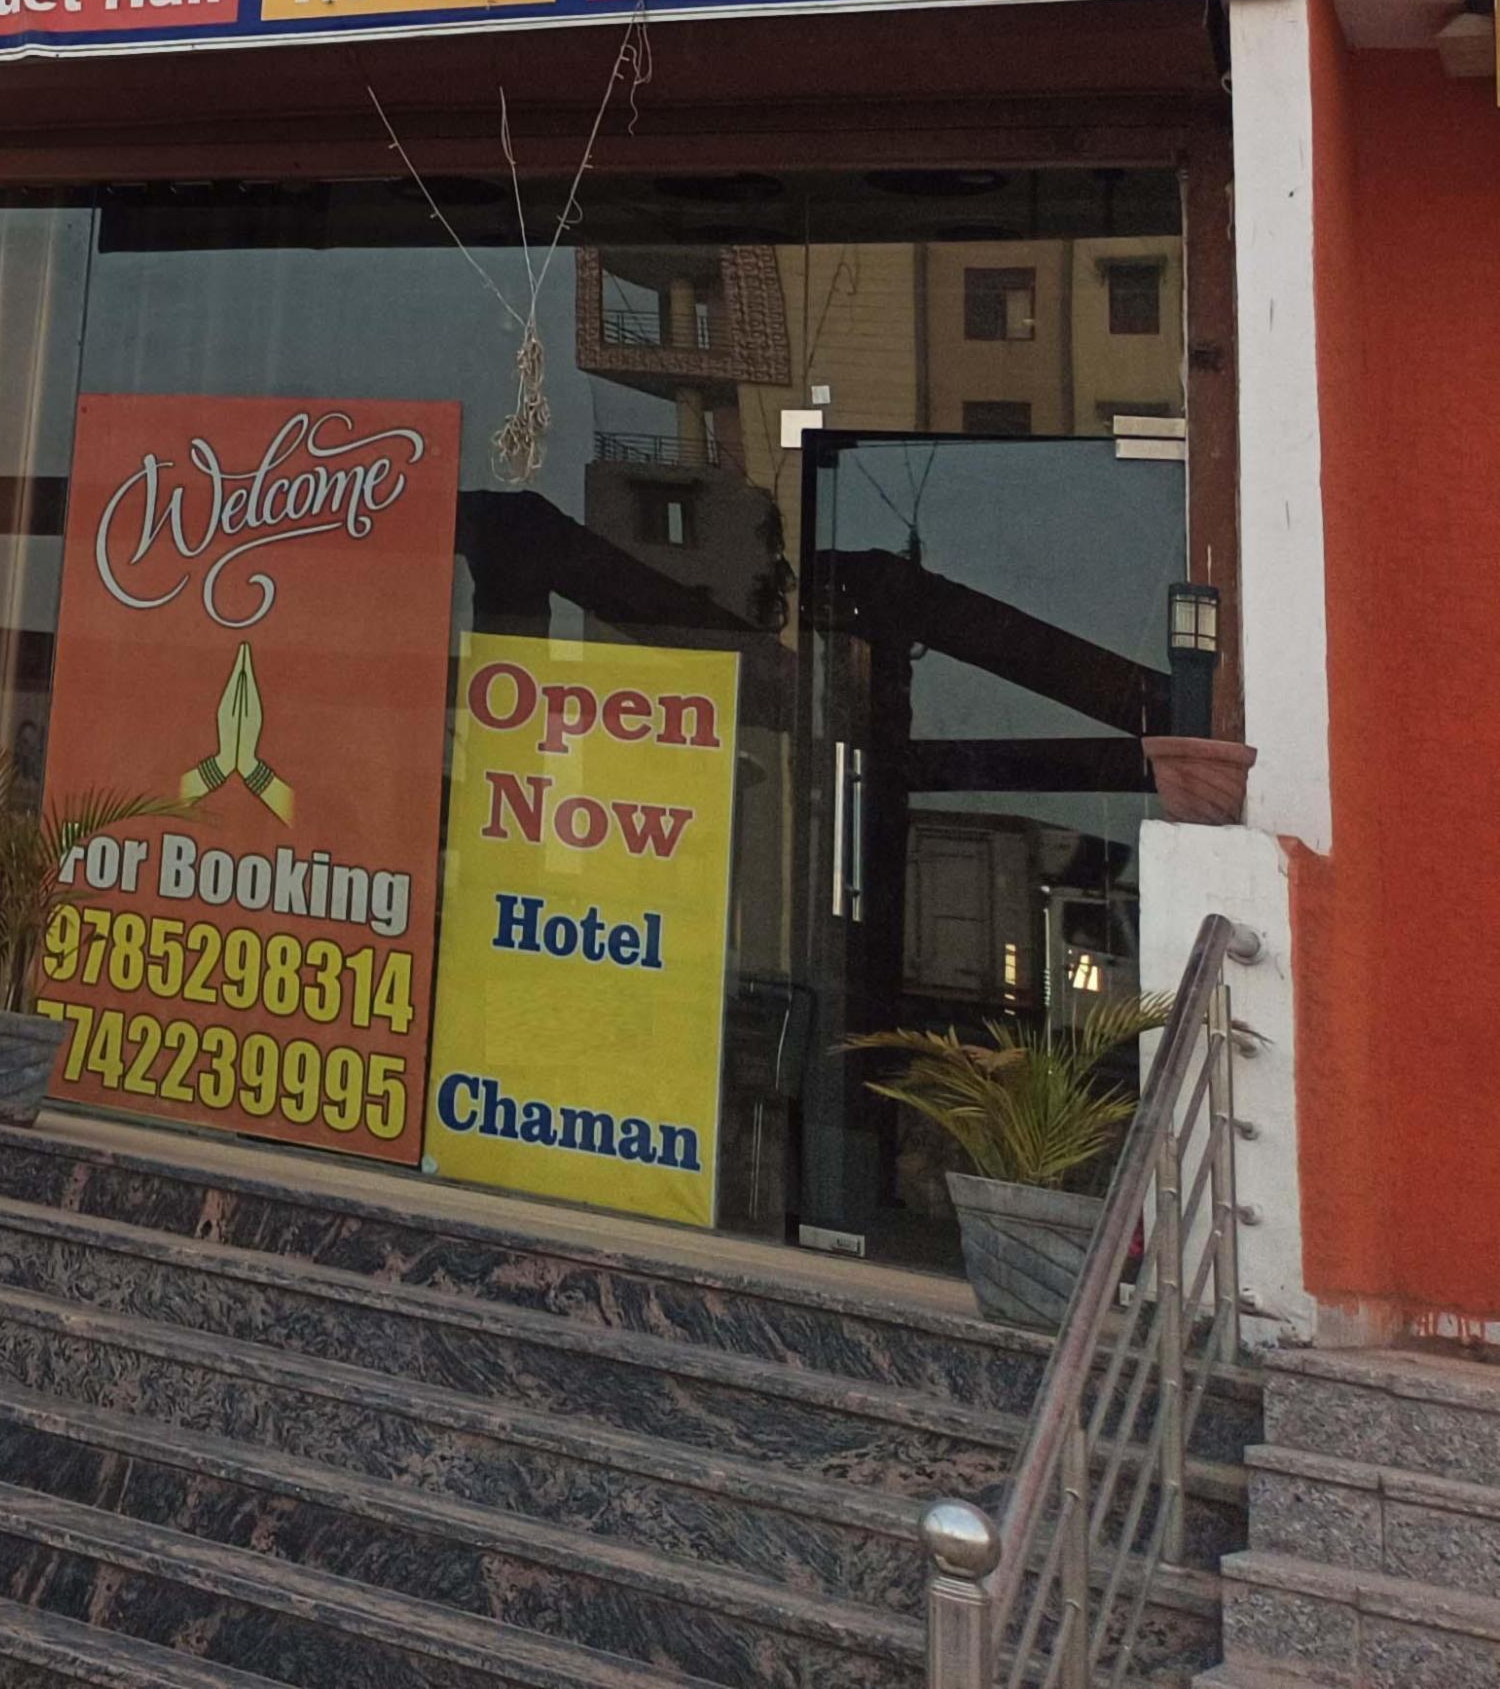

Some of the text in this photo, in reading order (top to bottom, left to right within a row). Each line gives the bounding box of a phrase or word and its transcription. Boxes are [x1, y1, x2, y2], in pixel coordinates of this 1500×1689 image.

[95, 413, 424, 629] Welcome
[466, 662, 723, 753] Open
[481, 771, 694, 859] Now
[159, 832, 411, 936] Booking
[492, 893, 665, 970] Hotel
[41, 904, 416, 1034] 9785298314
[436, 1071, 703, 1174] Chaman
